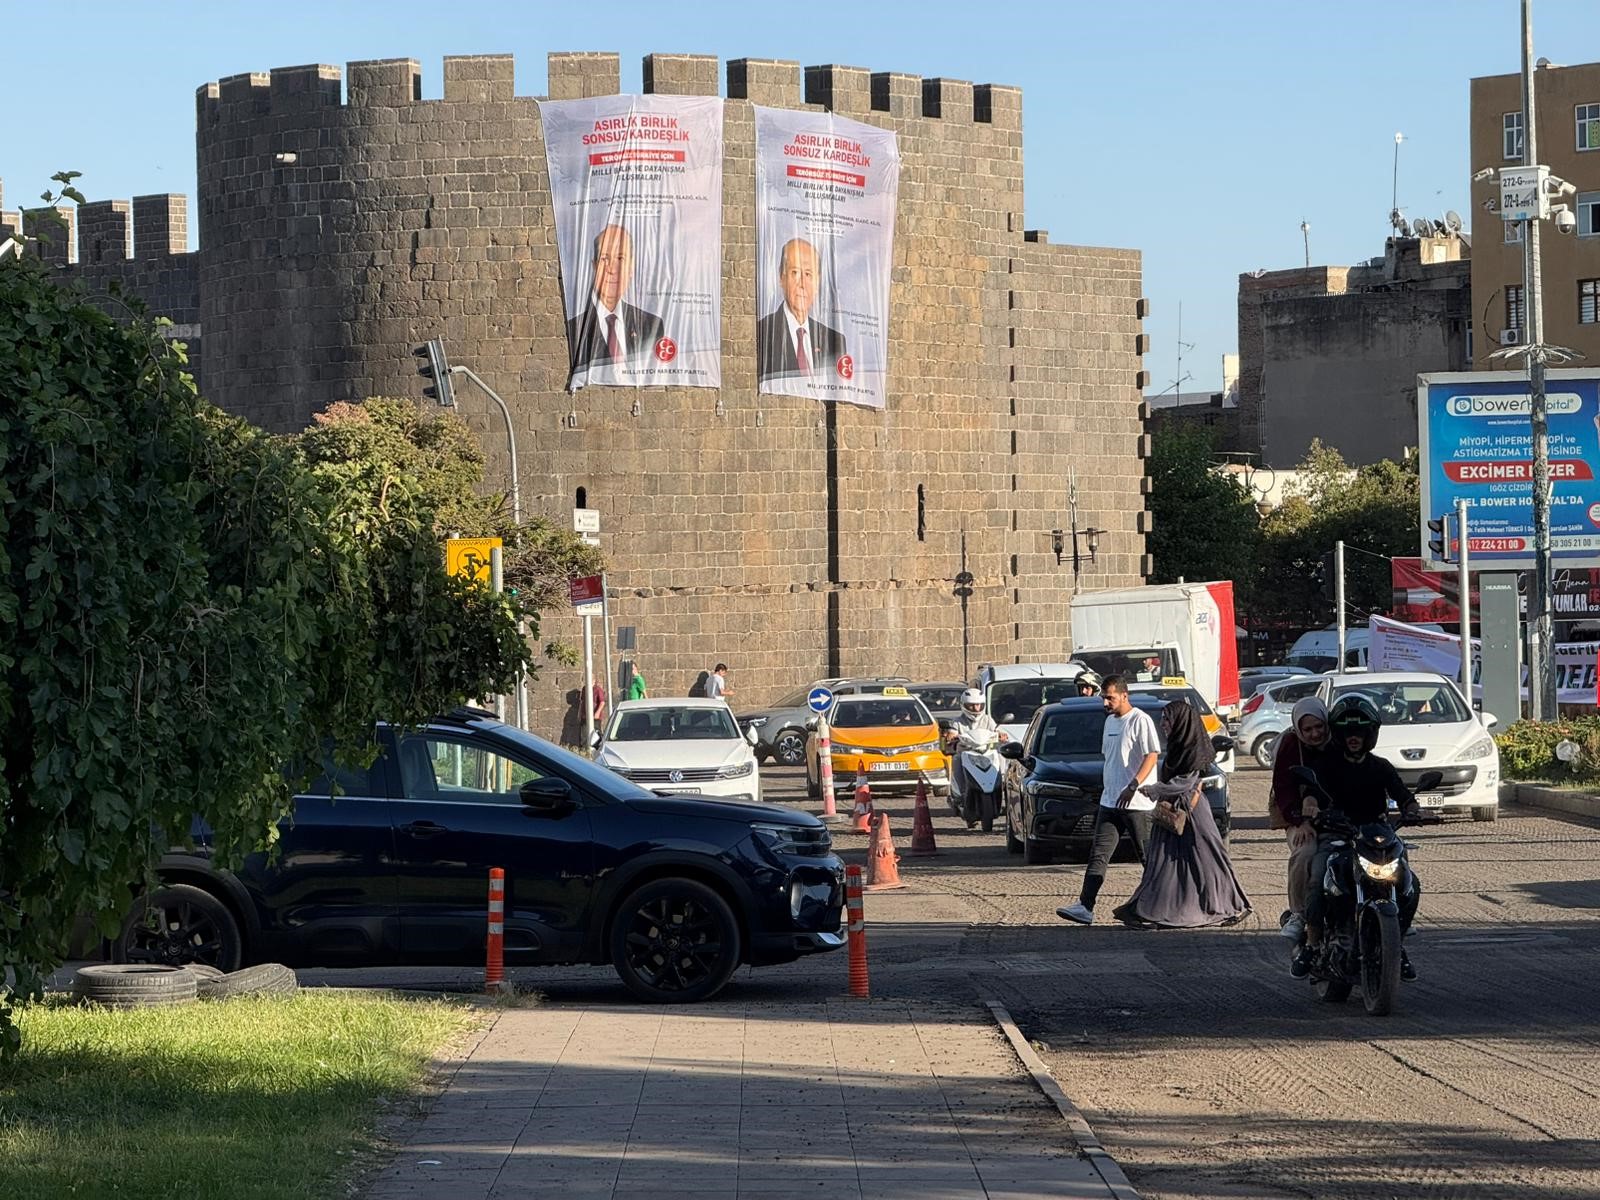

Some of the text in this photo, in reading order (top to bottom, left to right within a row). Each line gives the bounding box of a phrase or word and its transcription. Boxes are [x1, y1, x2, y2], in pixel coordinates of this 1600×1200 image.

[641, 115, 677, 128] BİRLİK
[630, 128, 689, 143] KARDEŞLİK
[794, 134, 862, 153] ASIRLIK BİRLİK
[784, 144, 871, 167] SONSUZ KARDEŞLİK
[1460, 435, 1493, 447] MİYOPİ,
[1565, 436, 1576, 444] ve
[1453, 448, 1520, 458] ASTİGMATİZMA
[1460, 463, 1576, 479] EXCİMER LZER
[1480, 498, 1516, 507] BOWER
[1481, 540, 1496, 550] 224
[1497, 540, 1507, 550] 21
[1509, 539, 1519, 549] 00
[1560, 539, 1571, 548] 305
[1573, 539, 1581, 547] 21
[1583, 538, 1592, 547] 00
[1427, 796, 1442, 806] 898
